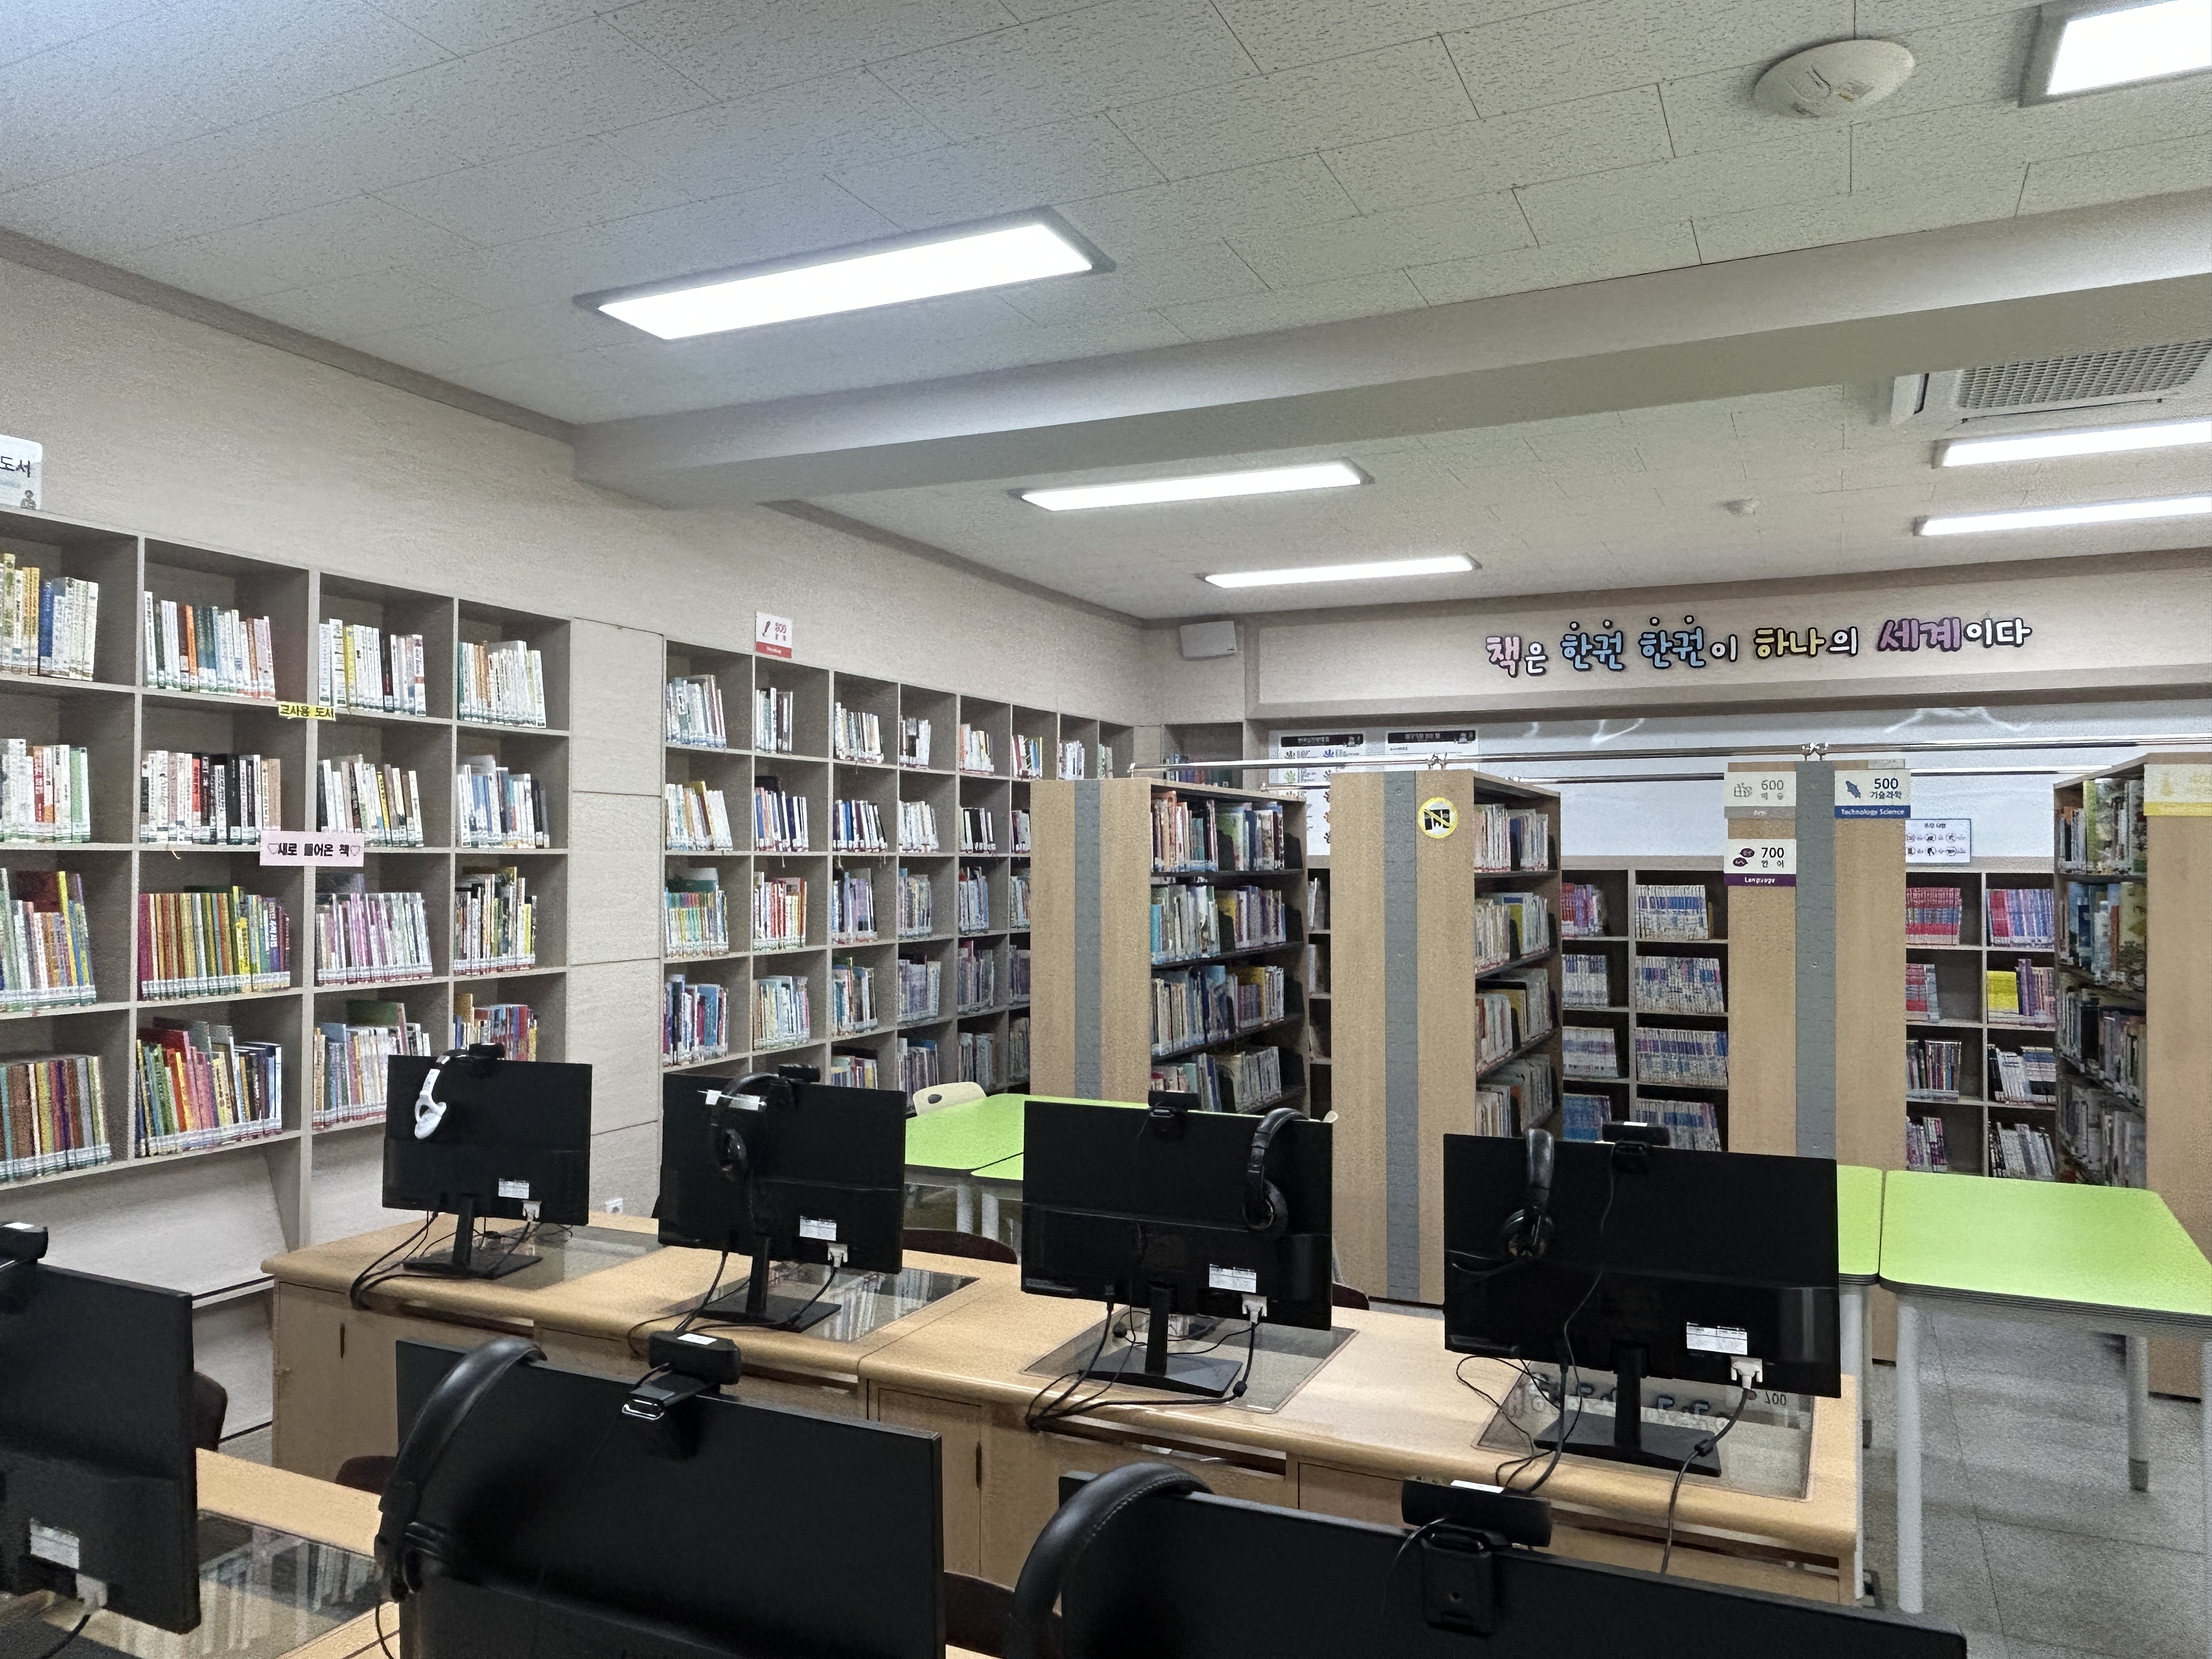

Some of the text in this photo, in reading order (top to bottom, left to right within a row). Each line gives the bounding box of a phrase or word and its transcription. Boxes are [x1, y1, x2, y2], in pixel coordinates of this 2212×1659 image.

[1486, 615, 2032, 678] 책은 한권 한권이 하나의 세계이다
[1761, 780, 1784, 791] 600
[1874, 778, 1899, 789] 500
[1761, 847, 1785, 858] 700
